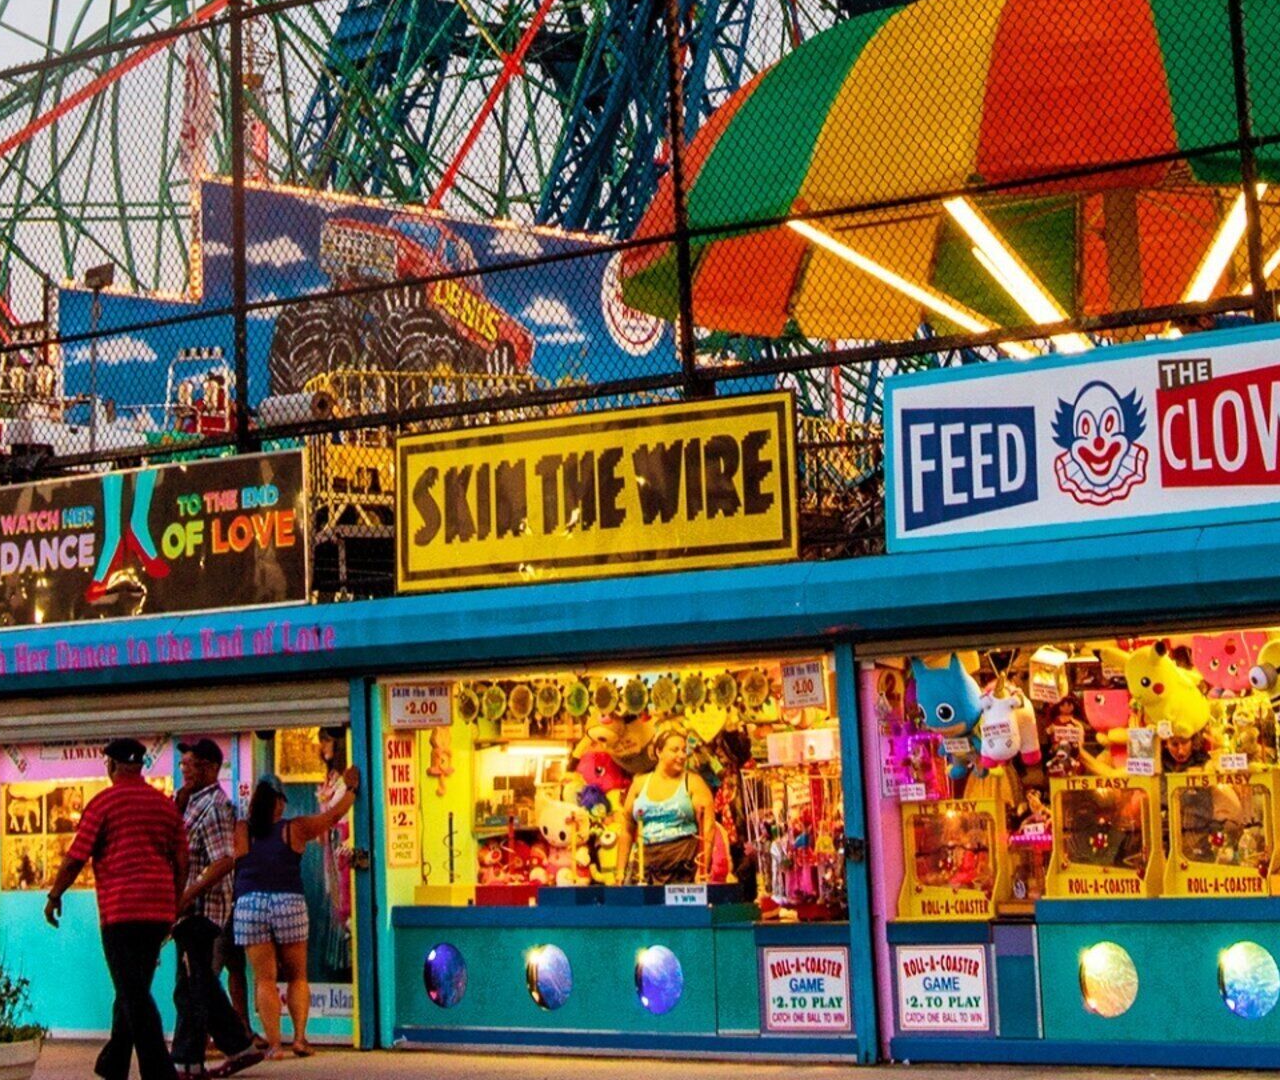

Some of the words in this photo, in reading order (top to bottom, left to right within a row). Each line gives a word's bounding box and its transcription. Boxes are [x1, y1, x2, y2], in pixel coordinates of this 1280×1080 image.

[1161, 358, 1210, 388] THE
[910, 421, 1028, 513] FEED
[412, 457, 528, 548] SKIN
[535, 446, 627, 536] THE
[632, 428, 775, 526] WIRE
[177, 493, 202, 517] TO
[204, 489, 238, 513] THE
[241, 483, 279, 510] END
[0, 508, 60, 536] WATCH
[62, 504, 95, 529] HER
[161, 520, 204, 560] OF
[211, 508, 297, 554] LOVE
[0, 532, 96, 575] DANCE
[14, 642, 51, 673] Her
[56, 639, 119, 673] Dance
[126, 635, 150, 667] to
[156, 630, 193, 664] the
[199, 624, 245, 660] End
[253, 620, 277, 656] of
[280, 620, 337, 656] Love
[388, 740, 412, 760] SKIN
[391, 764, 411, 783] THE
[1096, 778, 1130, 790] EASY
[389, 787, 415, 806] WIRE
[1068, 878, 1141, 895] ROLL-A-COASTER
[1187, 877, 1263, 894] ROLL-A-COASTER
[921, 900, 990, 916] ROLL-A-COASTER
[770, 956, 843, 980] ROLL-A-COASTER
[903, 955, 980, 979] ROLL-A-COASTER
[789, 978, 825, 993] GAME
[923, 977, 961, 992] GAME
[790, 997, 808, 1009] TO
[811, 997, 844, 1009] PLAY
[925, 996, 943, 1008] TO
[948, 996, 982, 1009] PLAY
[772, 1013, 791, 1023] CATCH
[793, 1013, 805, 1023] ONE
[807, 1013, 822, 1023] BALL
[905, 1012, 925, 1023] CATCH
[927, 1012, 940, 1023] ONE
[942, 1012, 958, 1023] BALL
[959, 1012, 968, 1023] TO
[970, 1012, 983, 1023] WIN
